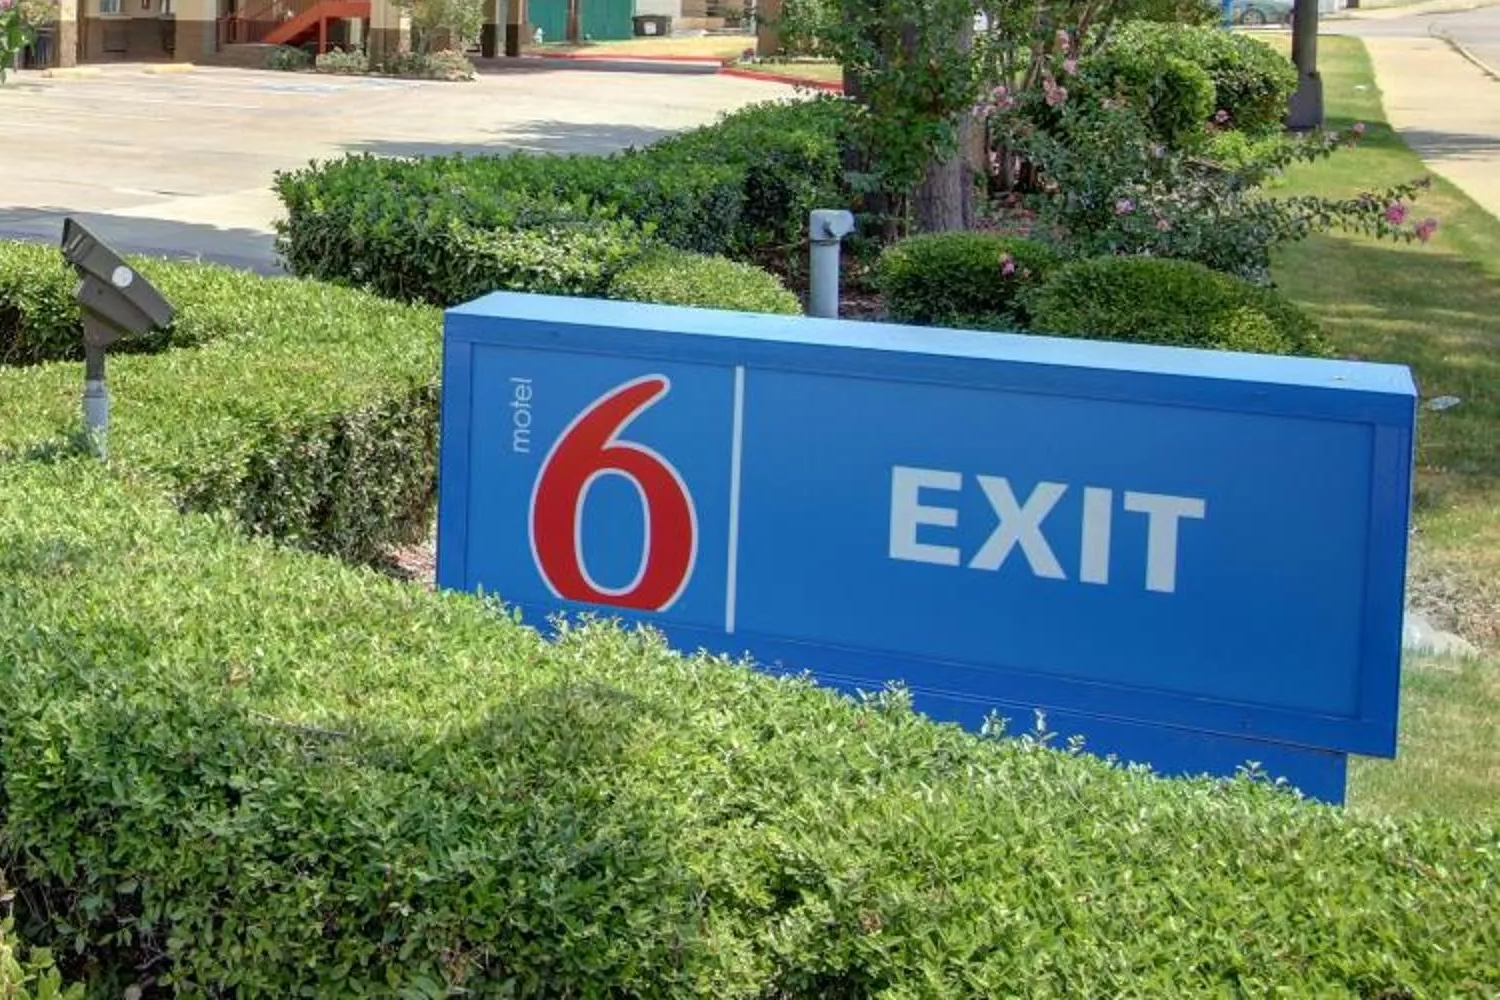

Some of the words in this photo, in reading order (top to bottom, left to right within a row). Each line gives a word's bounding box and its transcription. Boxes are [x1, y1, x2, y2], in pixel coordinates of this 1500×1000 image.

[509, 377, 533, 453] motel
[528, 373, 698, 613] 6
[889, 465, 1206, 593] EXIT
